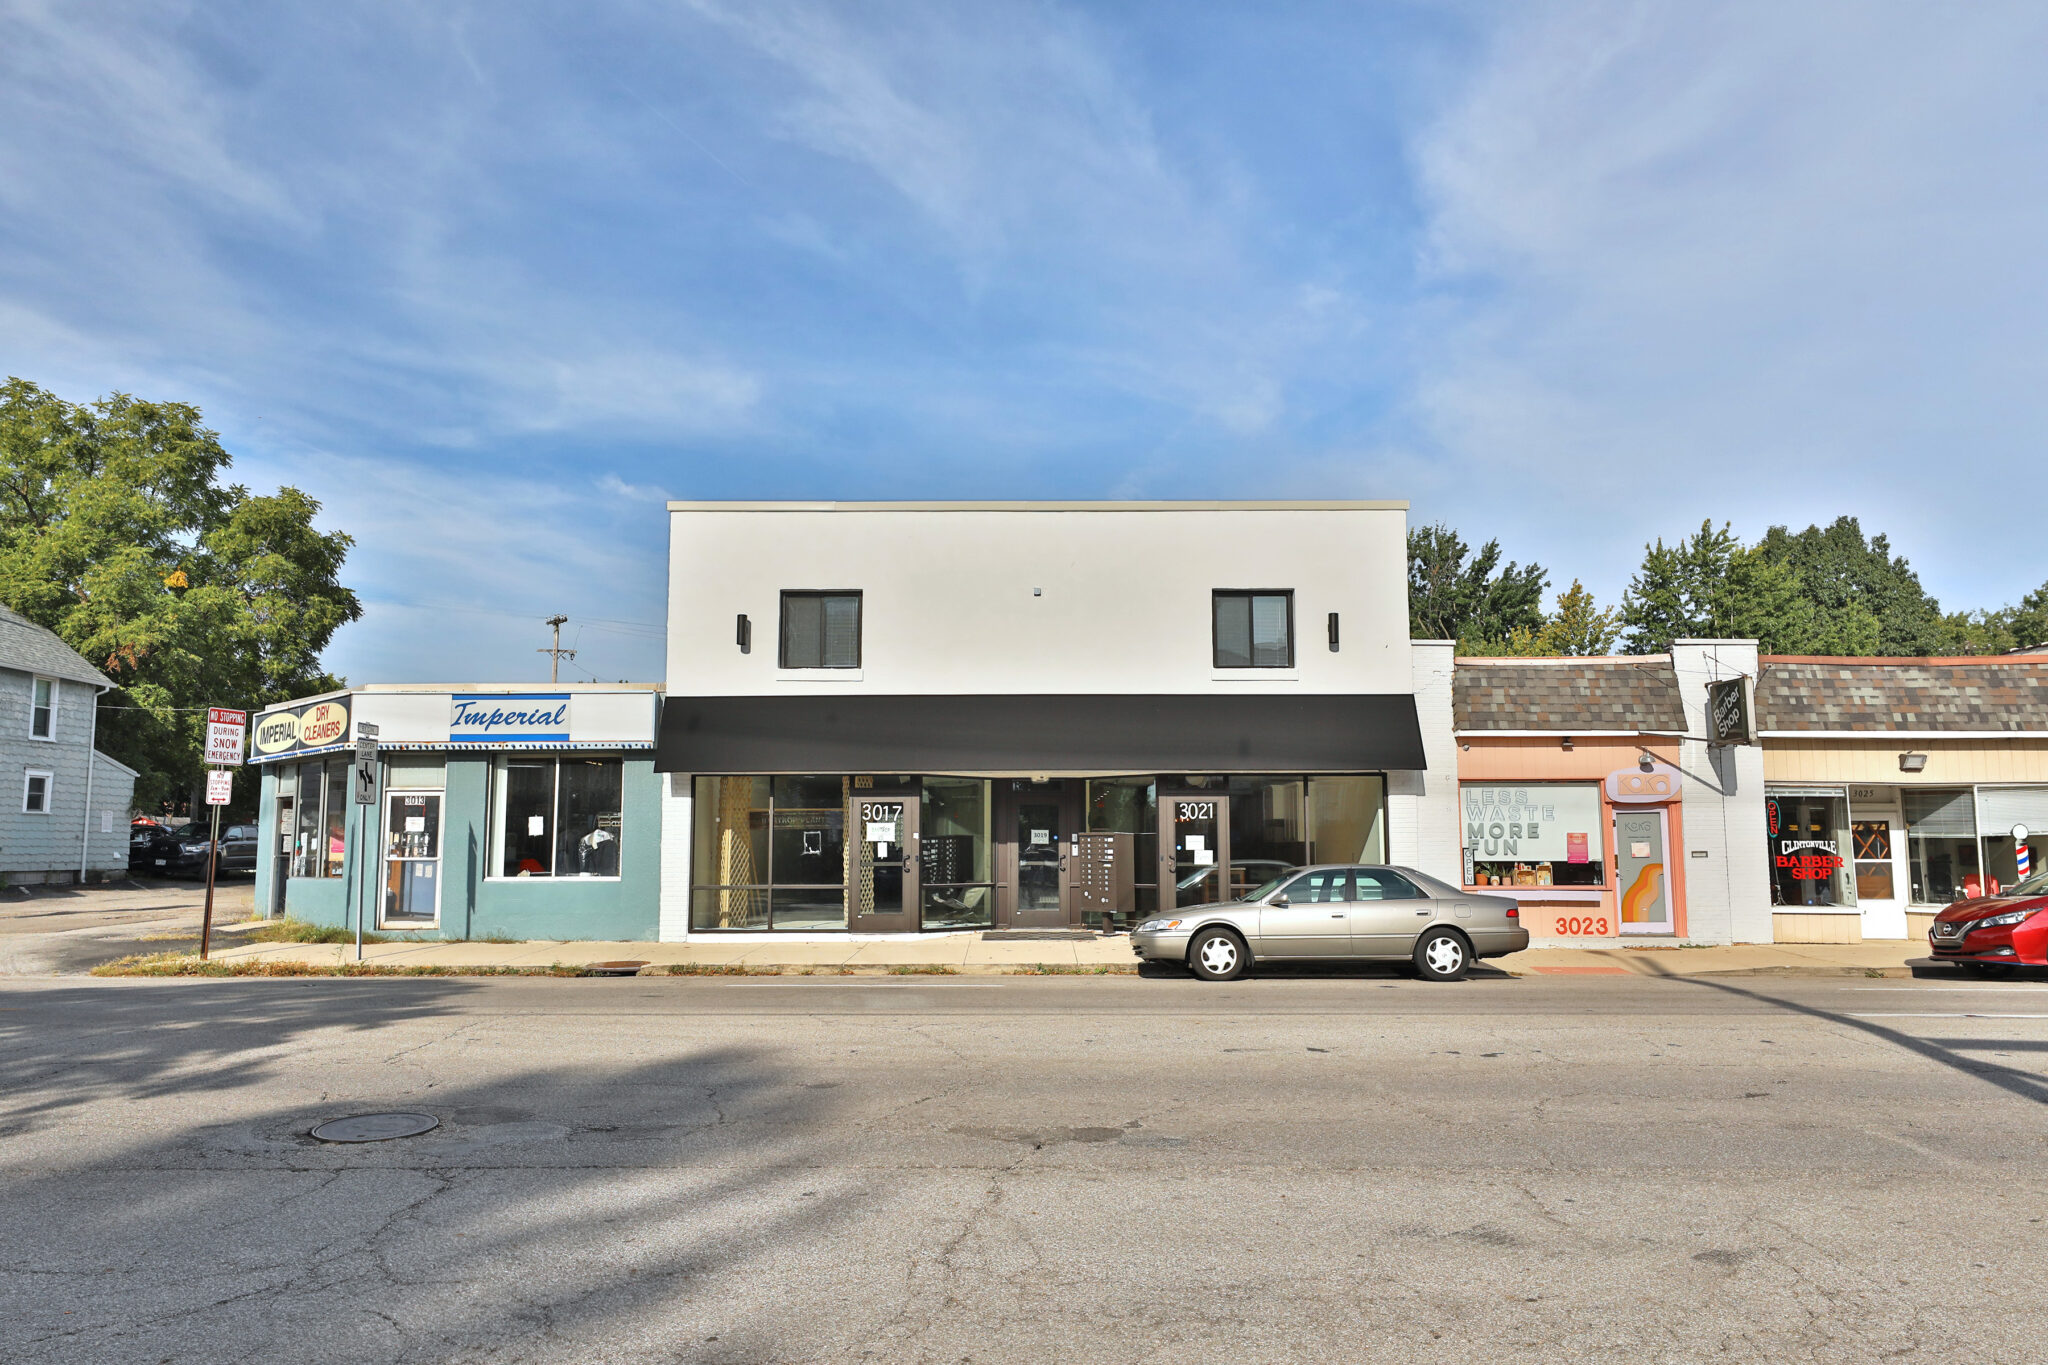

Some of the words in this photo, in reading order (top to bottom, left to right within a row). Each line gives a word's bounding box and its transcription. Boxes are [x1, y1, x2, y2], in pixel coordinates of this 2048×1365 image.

[315, 704, 330, 722] DRY
[1713, 686, 1740, 725] Barber
[210, 710, 219, 721] NO
[220, 711, 245, 724] STOPPING
[450, 701, 567, 732] Imperial
[1718, 708, 1740, 738] Shop
[213, 726, 239, 736] DURING
[260, 720, 297, 746] IMPERIAL
[303, 720, 341, 741] CLEANERS
[213, 737, 238, 749] SNOW
[359, 741, 375, 750] CENTER
[207, 750, 241, 761] EMERGENCY
[361, 750, 373, 758] LANE
[359, 793, 372, 802] ONLY
[405, 796, 425, 805] 3013
[1466, 788, 1528, 805] LESS
[1853, 789, 1875, 798] 3025
[862, 803, 902, 822] 3017
[1179, 803, 1214, 819] 3021
[1466, 805, 1555, 822] WASTE
[1768, 802, 1778, 834] OPEN
[1467, 822, 1540, 840] MORE
[1468, 839, 1518, 857] FUN
[1781, 840, 1837, 855] CLINTONVILLE
[1465, 849, 1473, 884] OPEN
[1776, 855, 1844, 868] BARBER
[1791, 867, 1832, 880] SHOP
[1555, 916, 1609, 936] 3023
